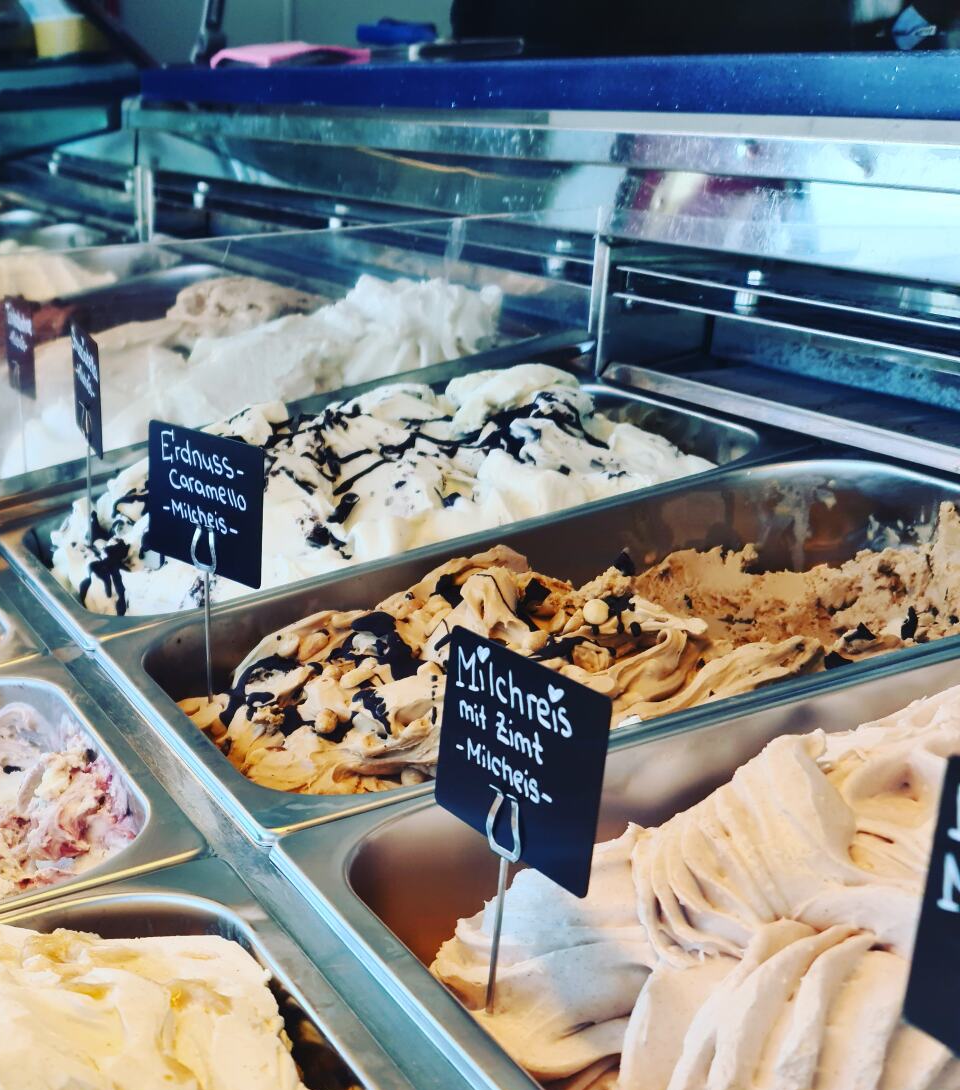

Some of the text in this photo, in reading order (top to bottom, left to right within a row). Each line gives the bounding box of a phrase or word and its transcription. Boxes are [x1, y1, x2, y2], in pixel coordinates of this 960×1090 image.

[161, 429, 244, 479] Erdnuss-
[169, 468, 247, 511] Caramello
[455, 645, 573, 738] Milchreis
[459, 699, 487, 730] mit
